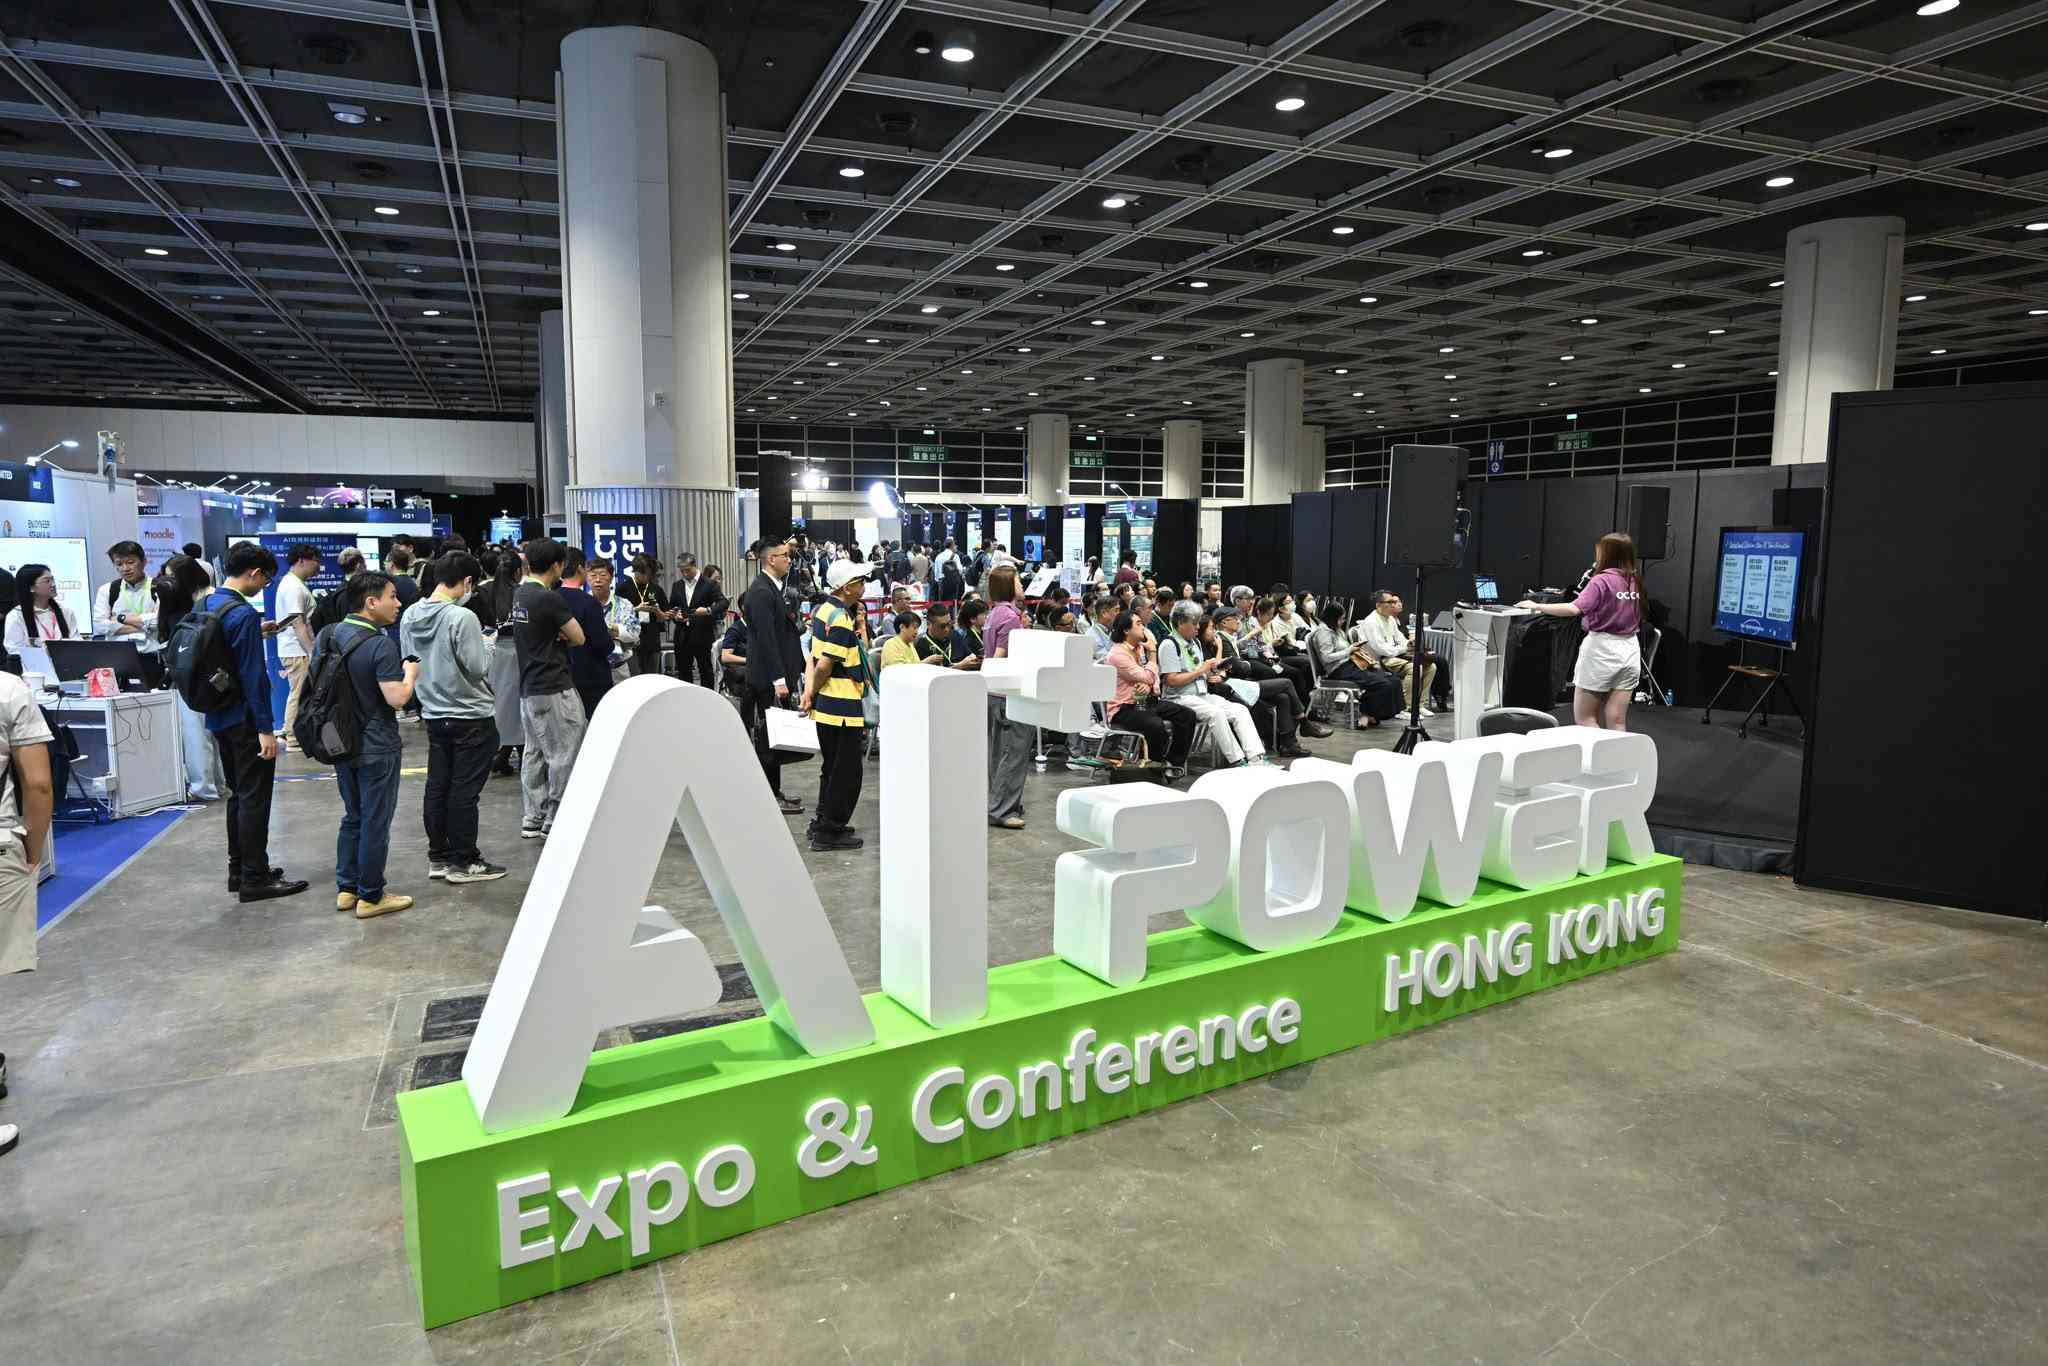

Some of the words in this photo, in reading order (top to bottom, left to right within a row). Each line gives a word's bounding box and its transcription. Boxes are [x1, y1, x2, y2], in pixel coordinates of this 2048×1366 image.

[144, 528, 175, 539] moodle
[1383, 921, 1533, 1012] HONG
[1547, 886, 1665, 965] KONG
[497, 1171, 756, 1269] Expo
[797, 1097, 879, 1178] &
[911, 997, 1301, 1144] Conference
